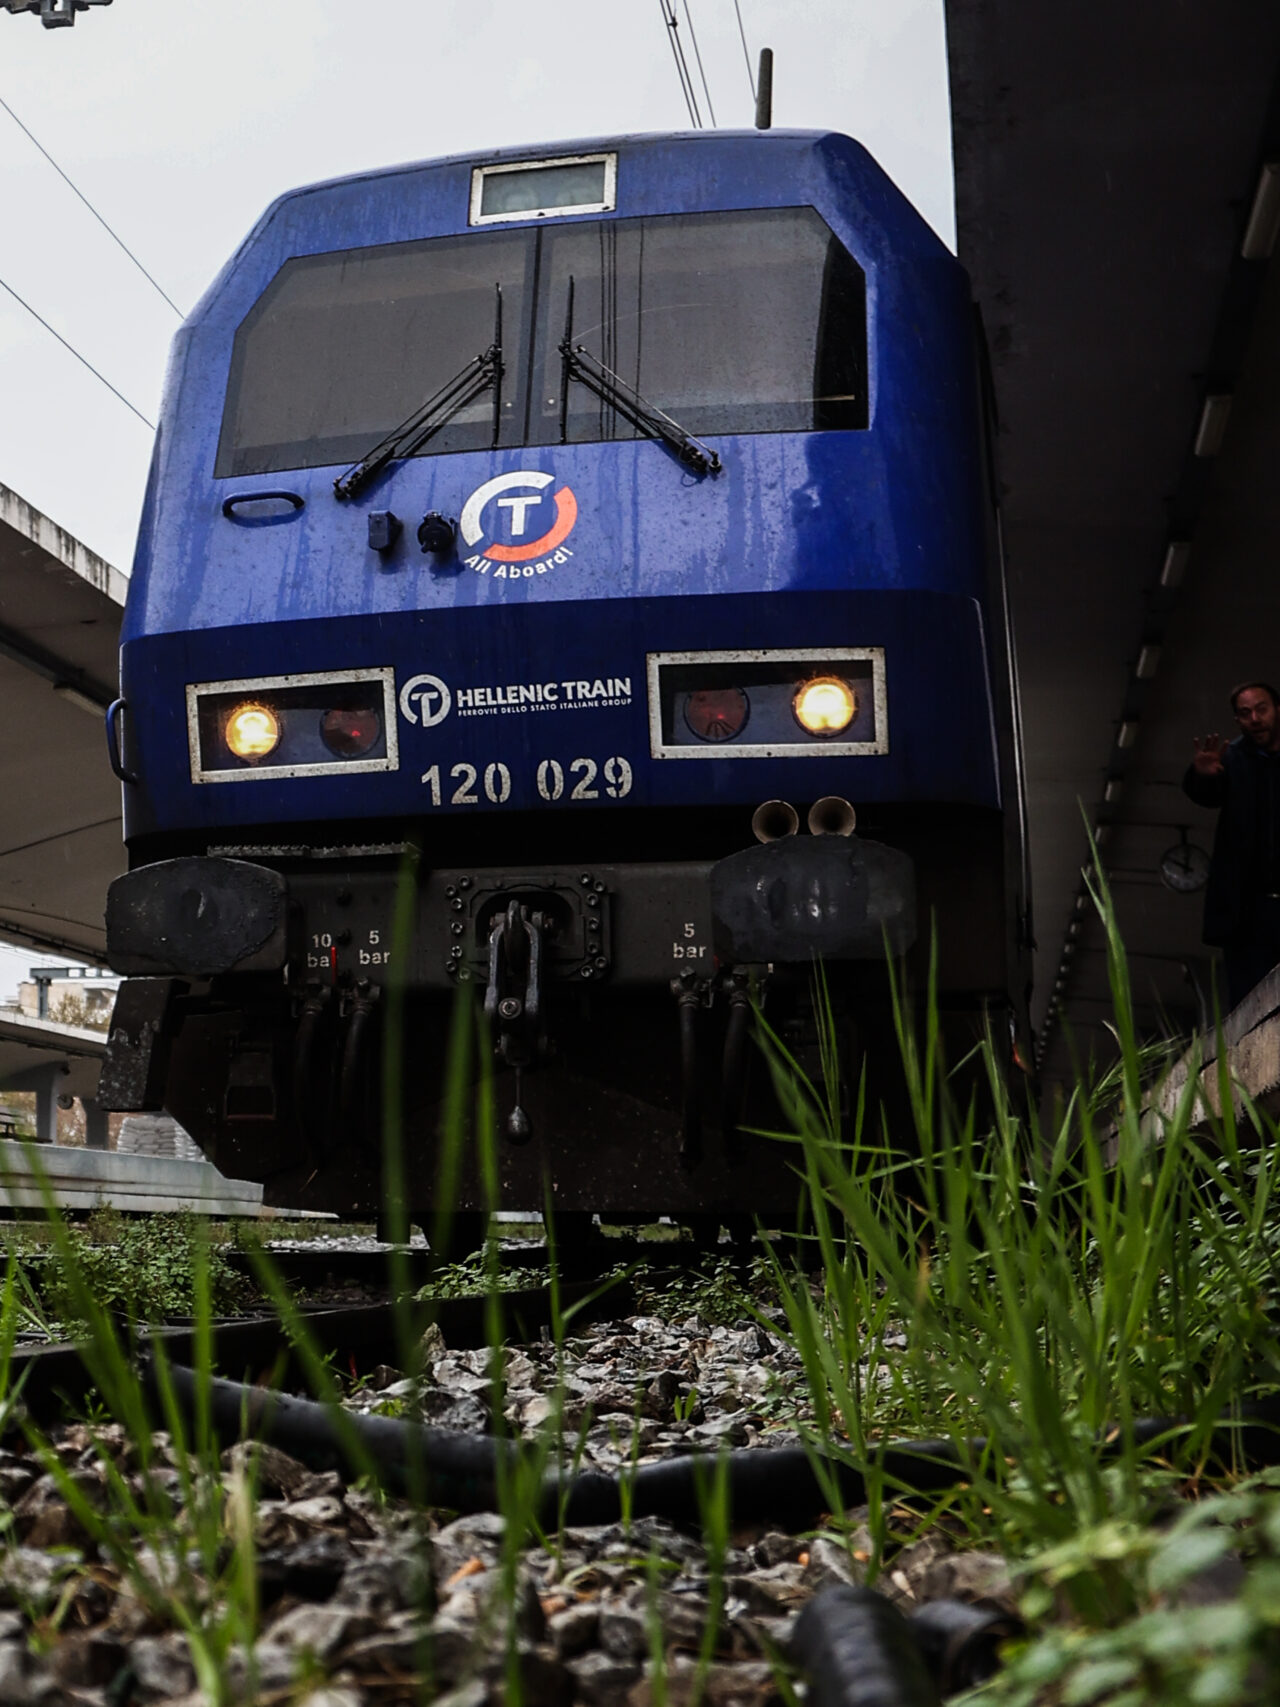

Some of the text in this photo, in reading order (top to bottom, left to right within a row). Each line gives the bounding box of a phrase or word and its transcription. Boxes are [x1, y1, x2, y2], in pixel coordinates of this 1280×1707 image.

[464, 546, 574, 579] All Aboard!
[456, 677, 632, 708] HELLENIC TRAIN
[458, 698, 632, 717] FERROVIE DELLO STATO ITALIANE GROUP
[421, 757, 633, 806] 120 029
[369, 930, 380, 945] 5
[684, 923, 695, 938] 5
[312, 933, 332, 948] 10
[360, 949, 391, 965] bar
[673, 943, 706, 958] bar
[307, 952, 335, 968] ba
